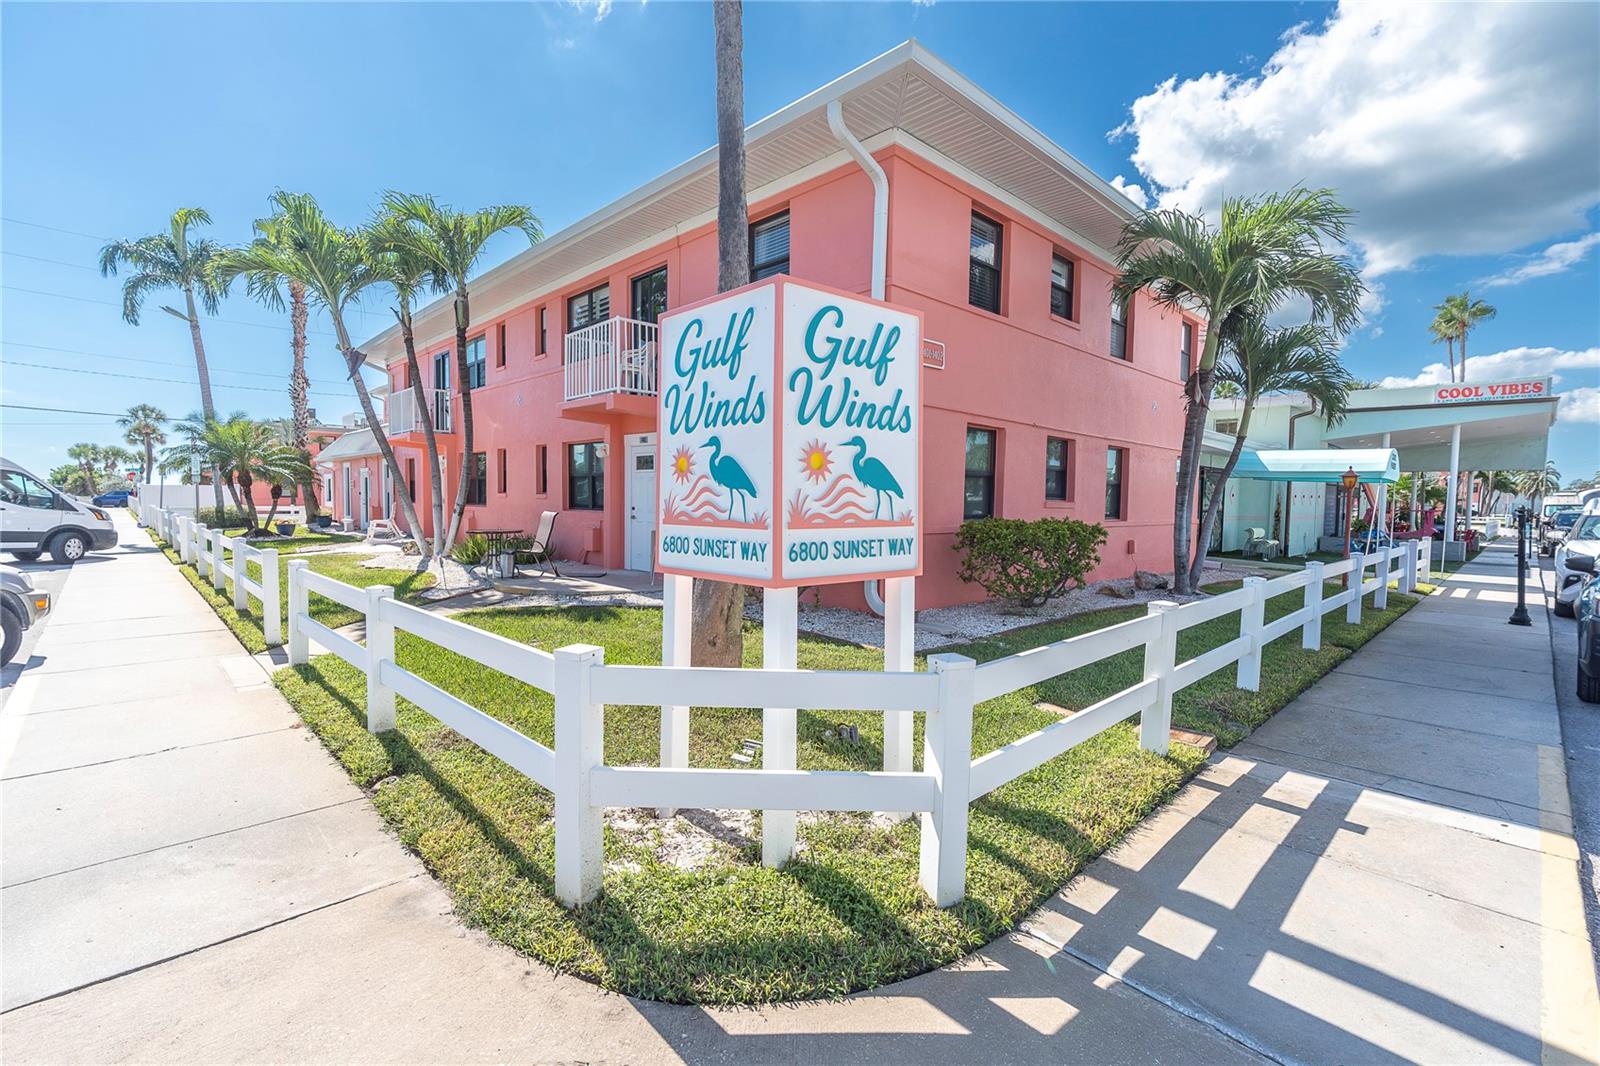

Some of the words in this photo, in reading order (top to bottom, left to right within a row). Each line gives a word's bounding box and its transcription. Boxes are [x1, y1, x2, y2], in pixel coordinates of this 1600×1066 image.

[674, 306, 755, 391] Gulf
[804, 305, 901, 386] Gulf
[664, 374, 767, 436] Winds
[788, 366, 912, 434] Winds
[1438, 386, 1483, 399] COOL
[1488, 382, 1543, 396] VIBES
[662, 535, 690, 556] 6800
[692, 537, 737, 560] SUNSET
[740, 541, 768, 563] WAY
[788, 540, 829, 563] 6800
[832, 539, 885, 560] SUNSET
[887, 537, 915, 556] WAY
